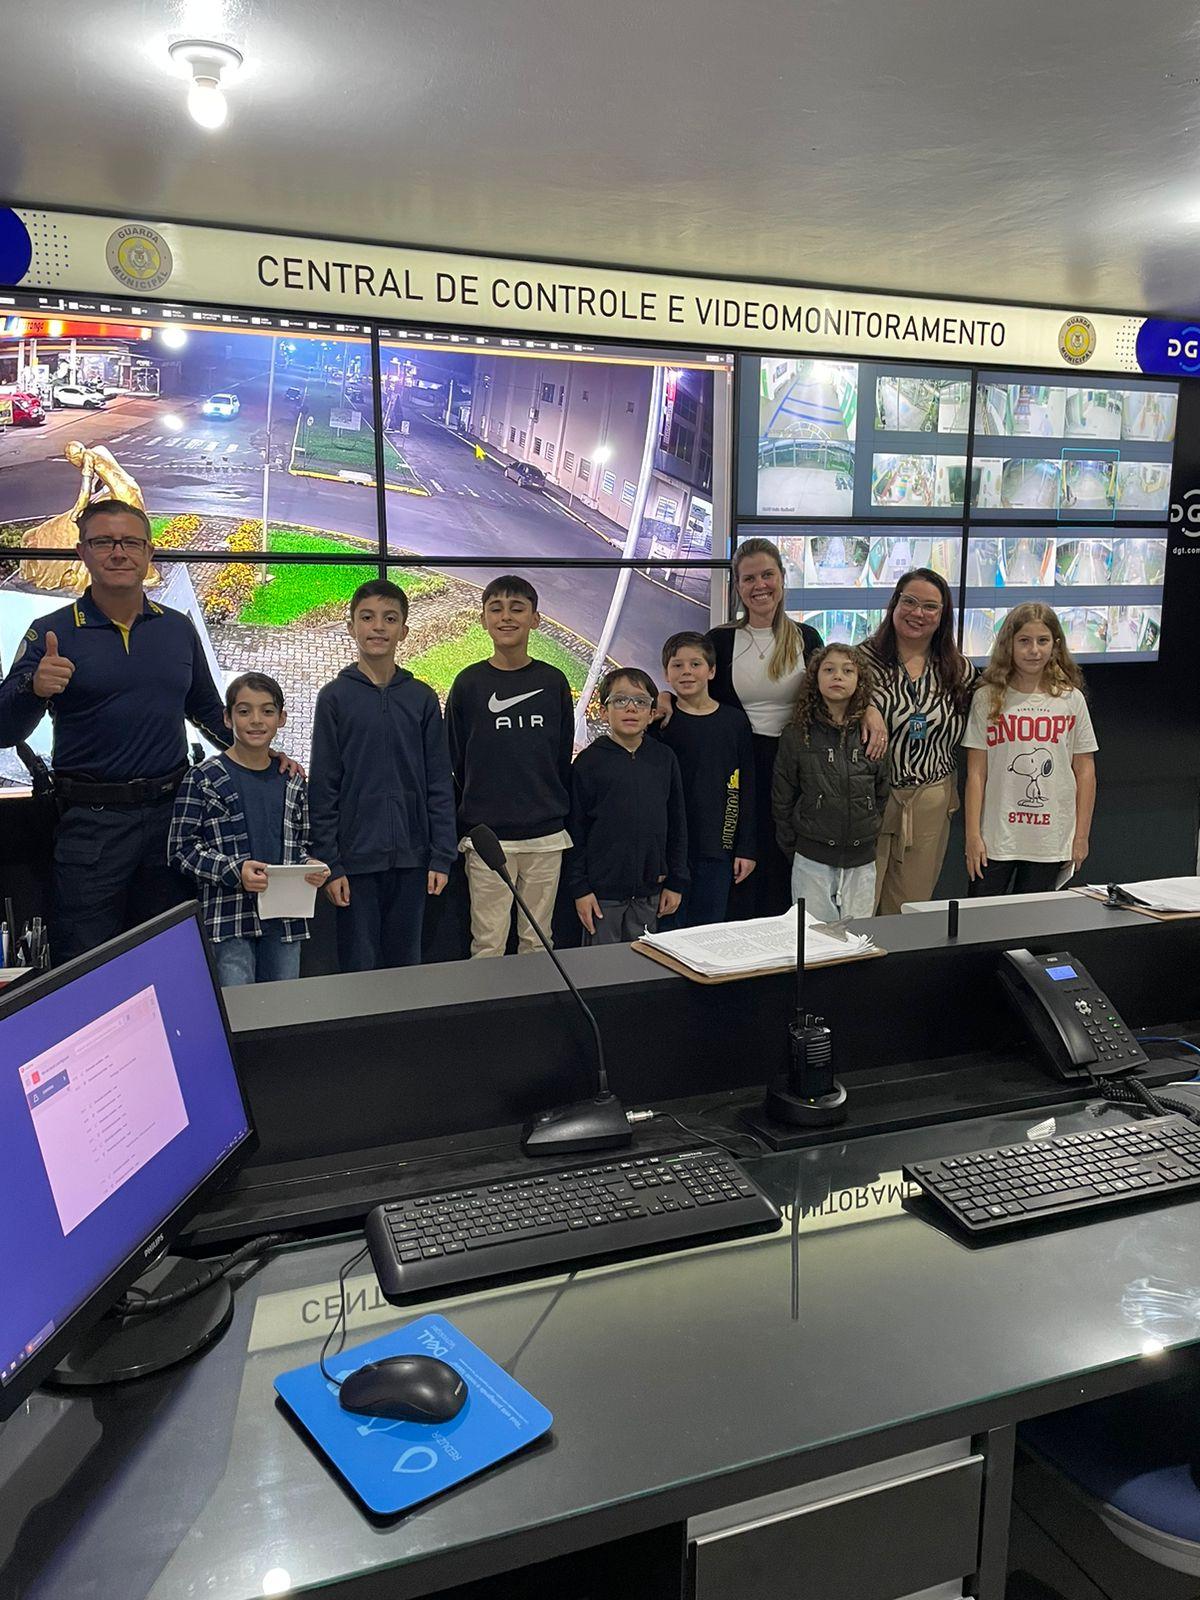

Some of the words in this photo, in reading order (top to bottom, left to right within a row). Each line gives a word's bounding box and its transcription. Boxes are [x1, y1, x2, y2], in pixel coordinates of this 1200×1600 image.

[117, 227, 159, 243] GUARDA
[112, 265, 169, 289] MUNICIPAL
[257, 255, 424, 300] CENTRAL
[436, 272, 479, 305] DE
[491, 278, 657, 321] CONTROLE
[669, 294, 685, 323] E
[695, 296, 1006, 347] VIDEOMONITORAMENTO
[495, 714, 544, 730] AIR
[1008, 811, 1051, 826] STYLE
[417, 1329, 448, 1358] DELL
